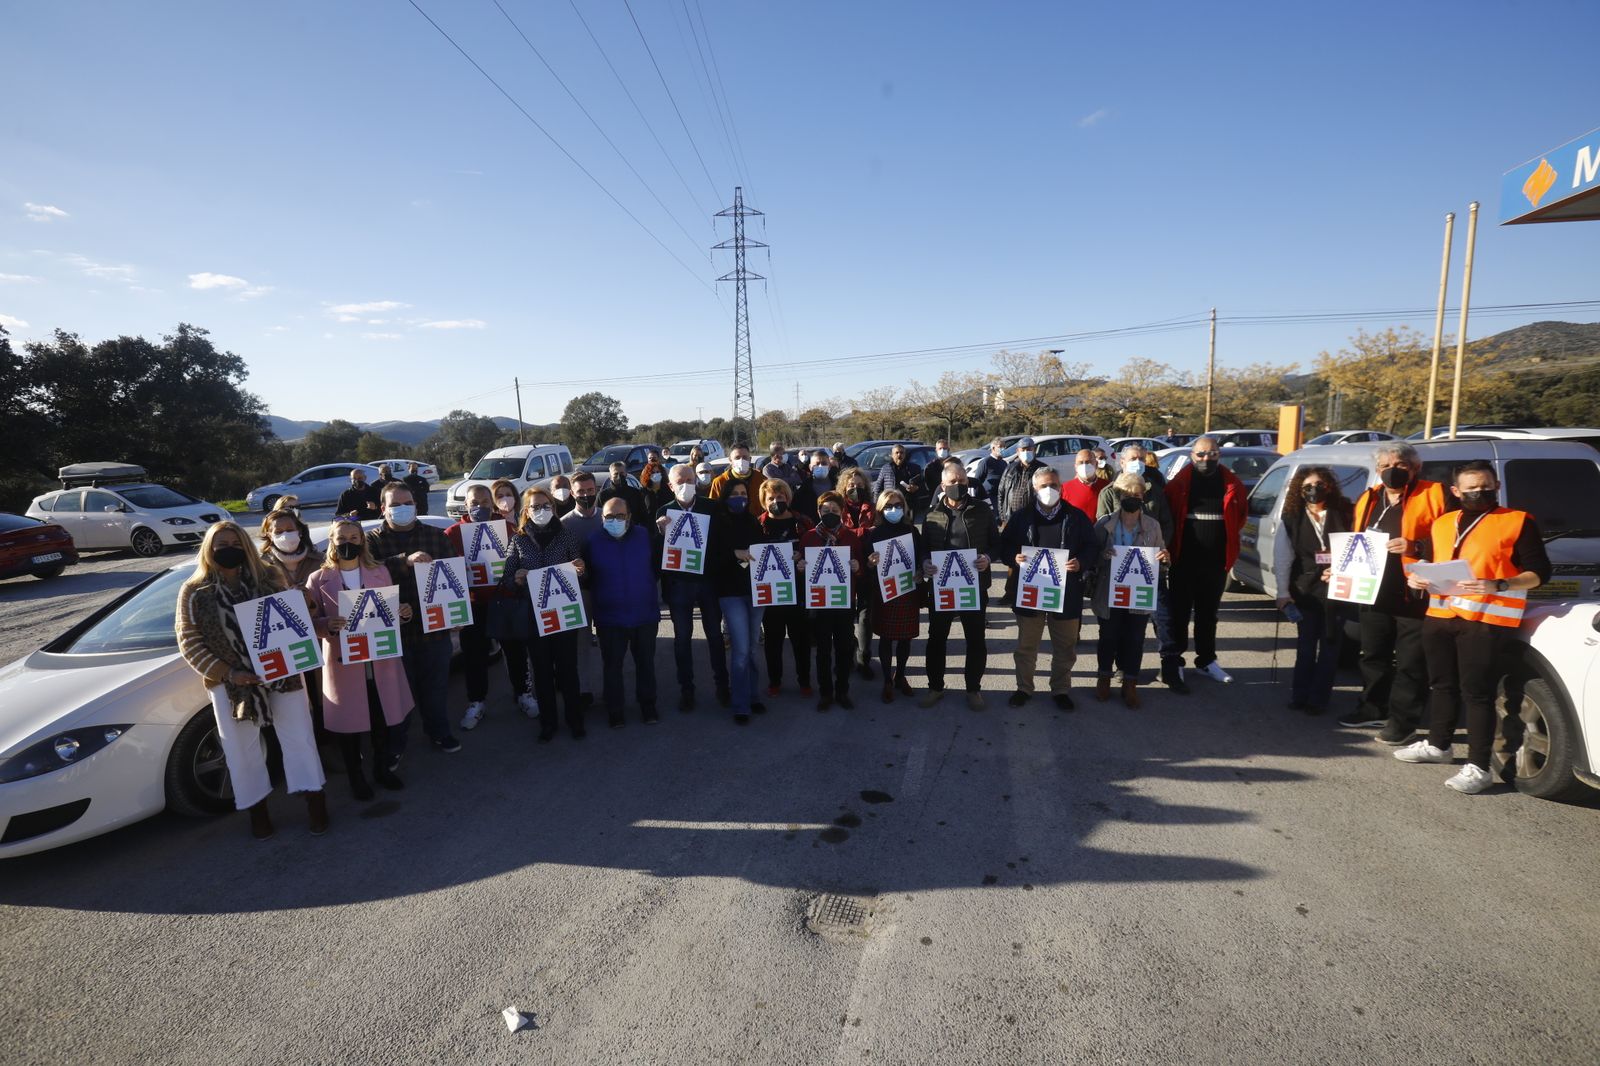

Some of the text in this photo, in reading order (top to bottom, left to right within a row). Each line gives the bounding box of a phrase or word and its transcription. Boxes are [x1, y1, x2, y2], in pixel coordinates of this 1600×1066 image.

[423, 563, 435, 602] PLATAFORMA
[445, 563, 465, 593] CIUDADANA
[557, 568, 577, 597] CIUDADANA
[809, 550, 824, 582] PLATAFORMA
[537, 570, 547, 607] PLATAFORMA
[277, 598, 309, 631] CIUDADANA
[344, 592, 365, 631] PLATAFORMA
[377, 592, 395, 622] CIUDADANA
[253, 601, 264, 648] PLATAFORMA
